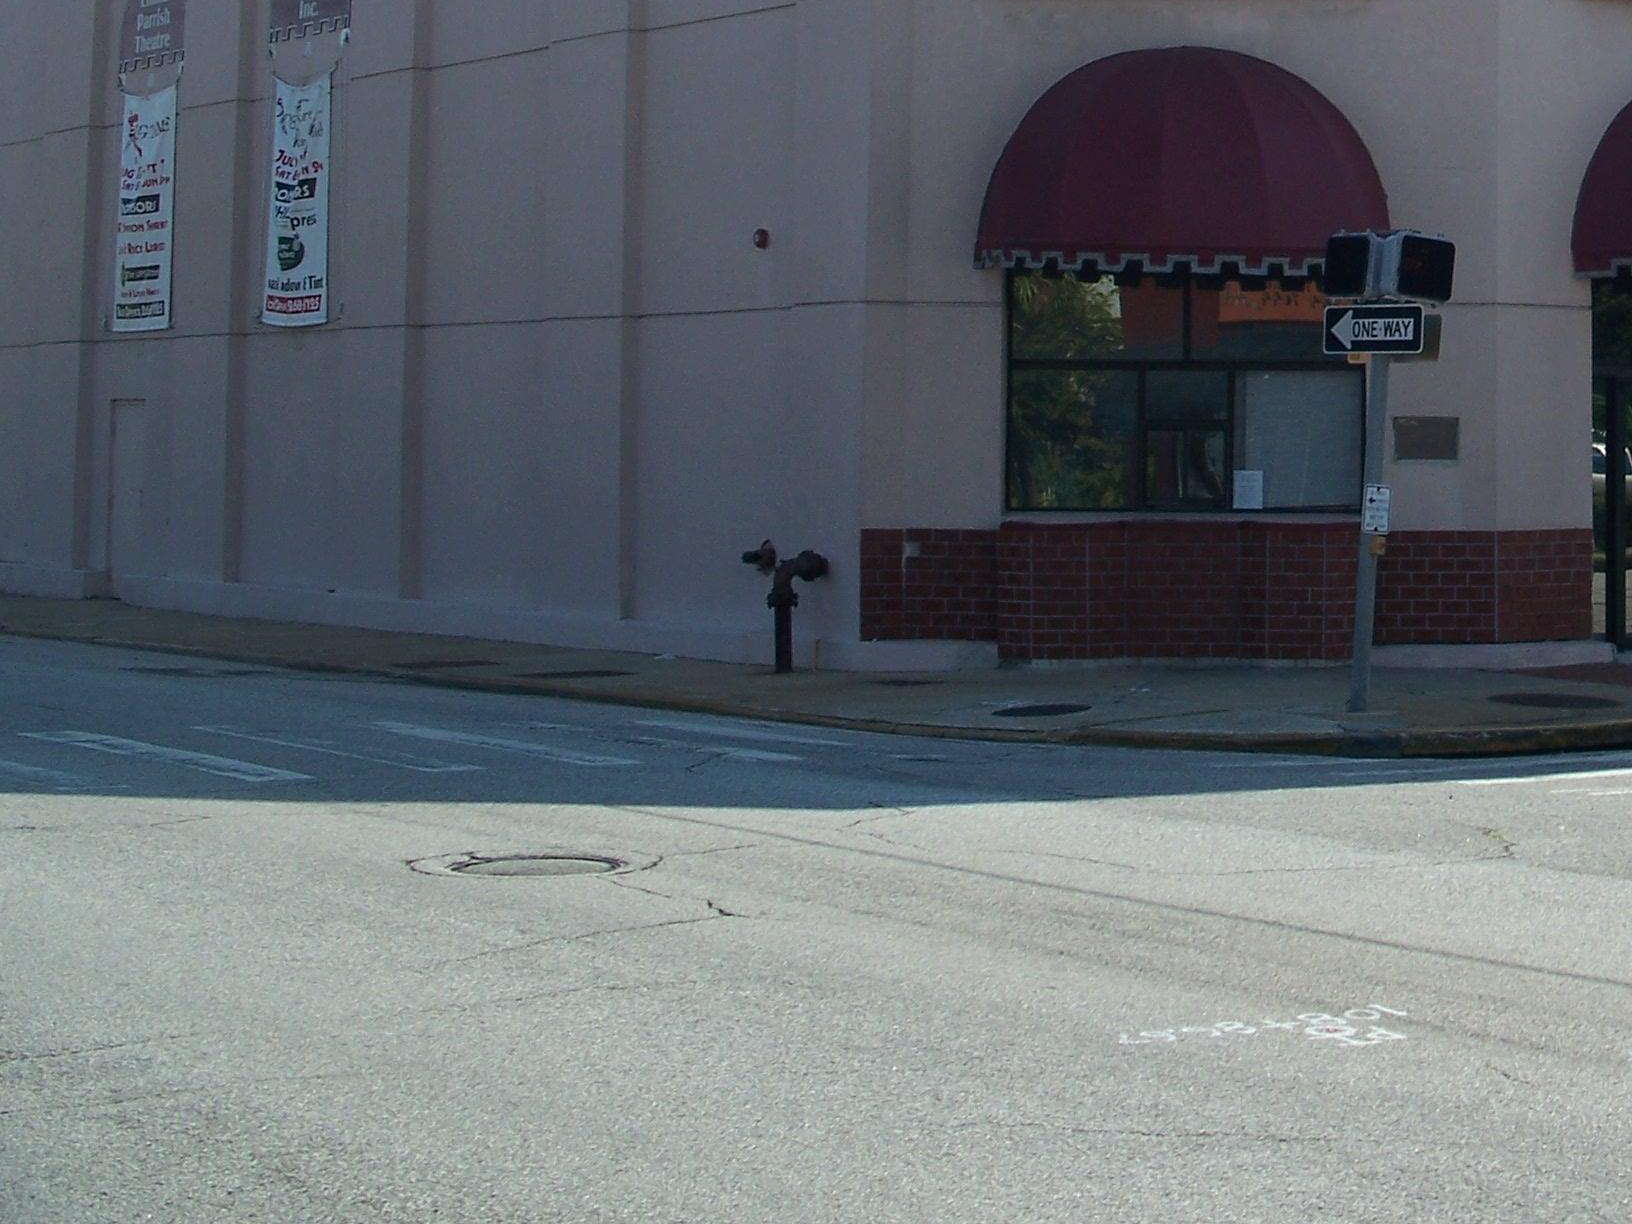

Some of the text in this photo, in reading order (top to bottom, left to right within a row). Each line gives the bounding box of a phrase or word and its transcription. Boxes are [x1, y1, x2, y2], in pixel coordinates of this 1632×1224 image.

[137, 8, 170, 31] Parrish
[135, 32, 170, 54] Theatre
[1352, 320, 1411, 337] ONE WAY
